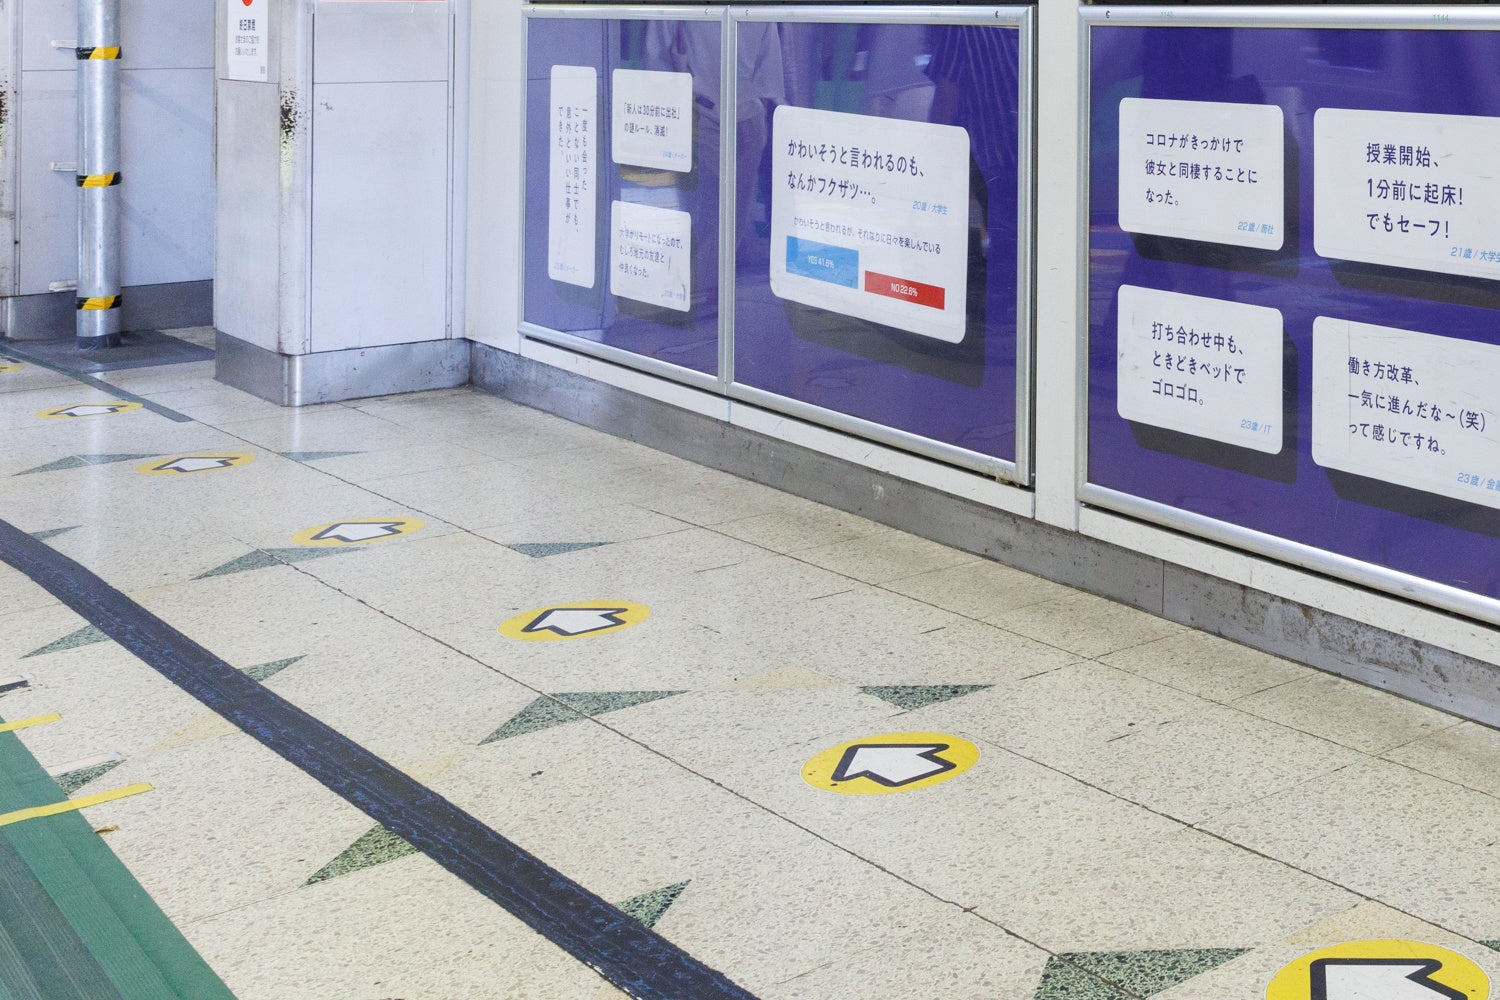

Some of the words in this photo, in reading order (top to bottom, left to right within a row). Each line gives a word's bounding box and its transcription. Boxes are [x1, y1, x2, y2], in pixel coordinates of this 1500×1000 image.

[1146, 132, 1244, 153] コロナがきっかけで
[1366, 142, 1439, 168] 授業開始、
[788, 139, 924, 177] かわいそうと言われるのも、
[1145, 159, 1257, 184] 彼女と同棲することに
[788, 170, 876, 204] なんかフクザツ…。
[1146, 187, 1179, 206] なった。
[1367, 178, 1463, 206] 1分前に起床!
[1366, 211, 1449, 239] でもセーフ!
[891, 282, 900, 292] NO
[1152, 321, 1243, 355] 打ち合わせ中も、
[1152, 351, 1246, 385] ときどきベッドで
[1347, 355, 1420, 386] 働き方改革、
[1152, 378, 1204, 406] ゴロゴロ。
[1349, 422, 1447, 456] って感じですね。
